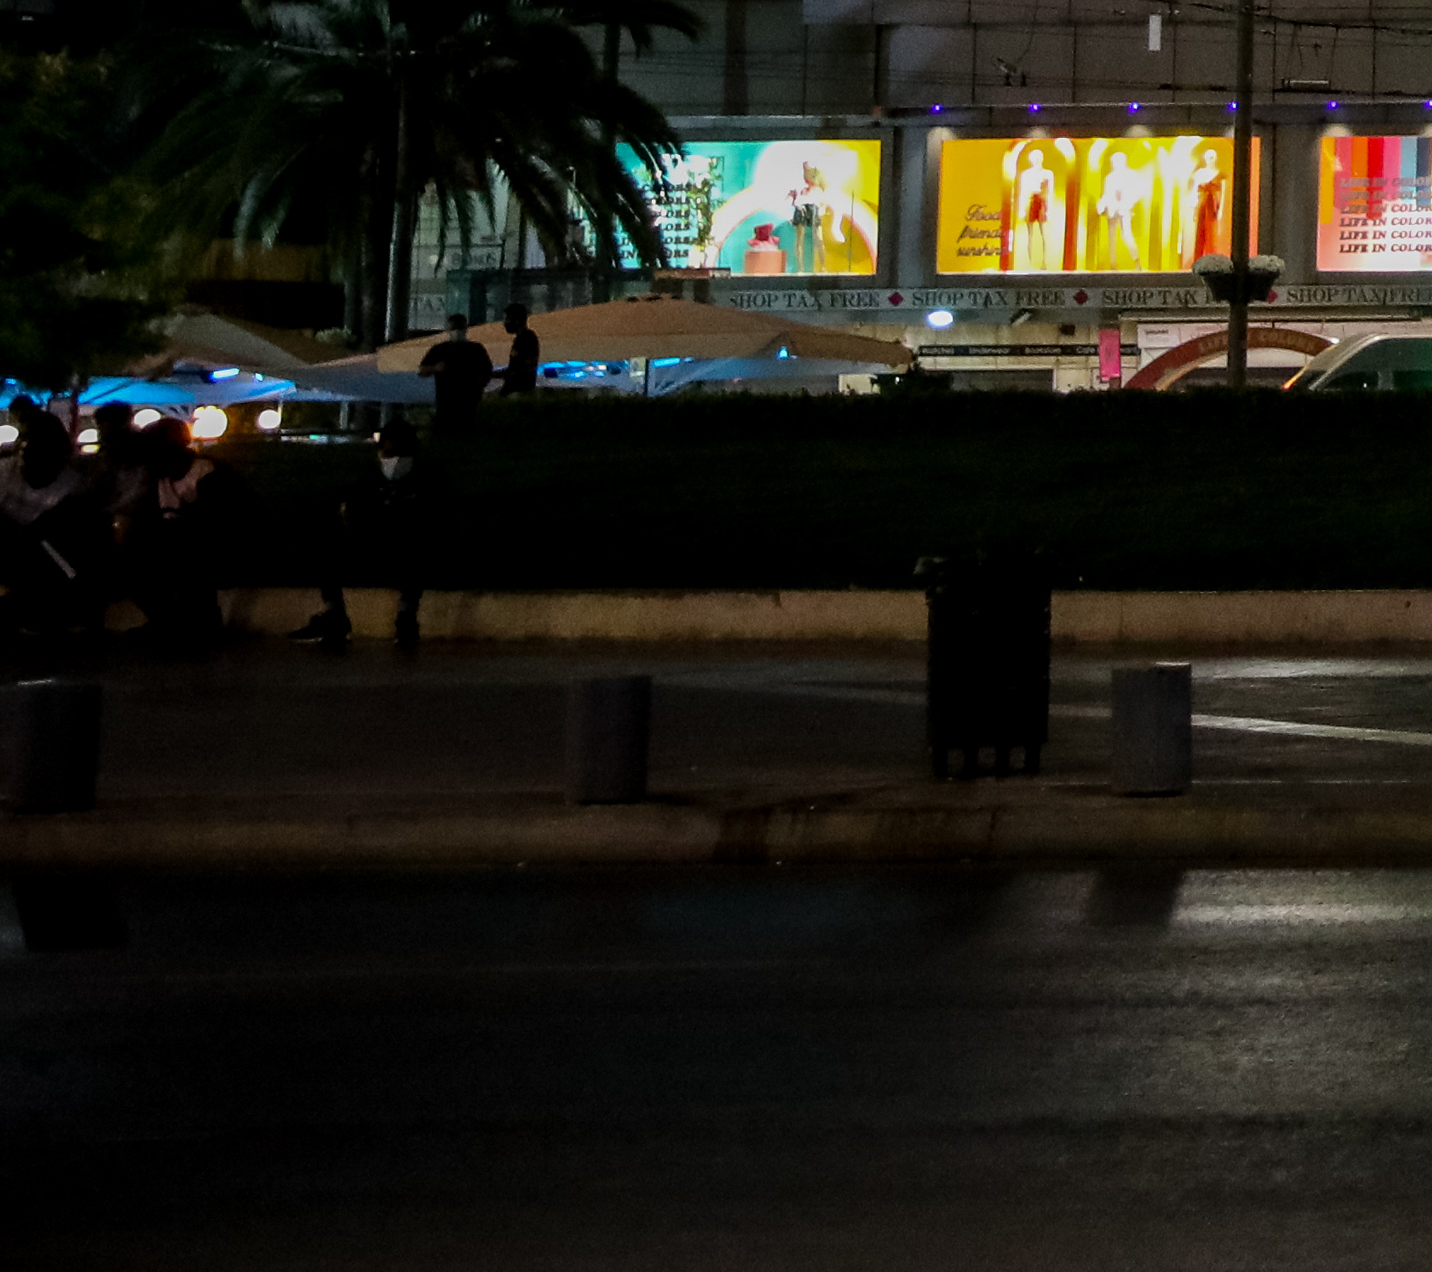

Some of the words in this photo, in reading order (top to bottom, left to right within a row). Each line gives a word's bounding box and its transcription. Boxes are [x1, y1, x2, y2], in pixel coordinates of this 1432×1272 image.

[1339, 217, 1368, 227] LIFE
[1372, 217, 1387, 227] IN
[1339, 230, 1369, 240] LIFE
[1372, 230, 1387, 240] IN
[1339, 244, 1369, 254] LIFE
[1372, 244, 1387, 254] IN
[730, 293, 779, 307] SHOP
[784, 293, 822, 308] TAX
[830, 291, 881, 306] FREE
[911, 290, 965, 306] SHOP
[968, 290, 1010, 306] TAX
[1015, 289, 1066, 305] FREE
[1102, 289, 1154, 305] SHOP
[1157, 289, 1202, 305] TAX
[1286, 288, 1338, 305] SHOP
[1341, 288, 1388, 305] TAX
